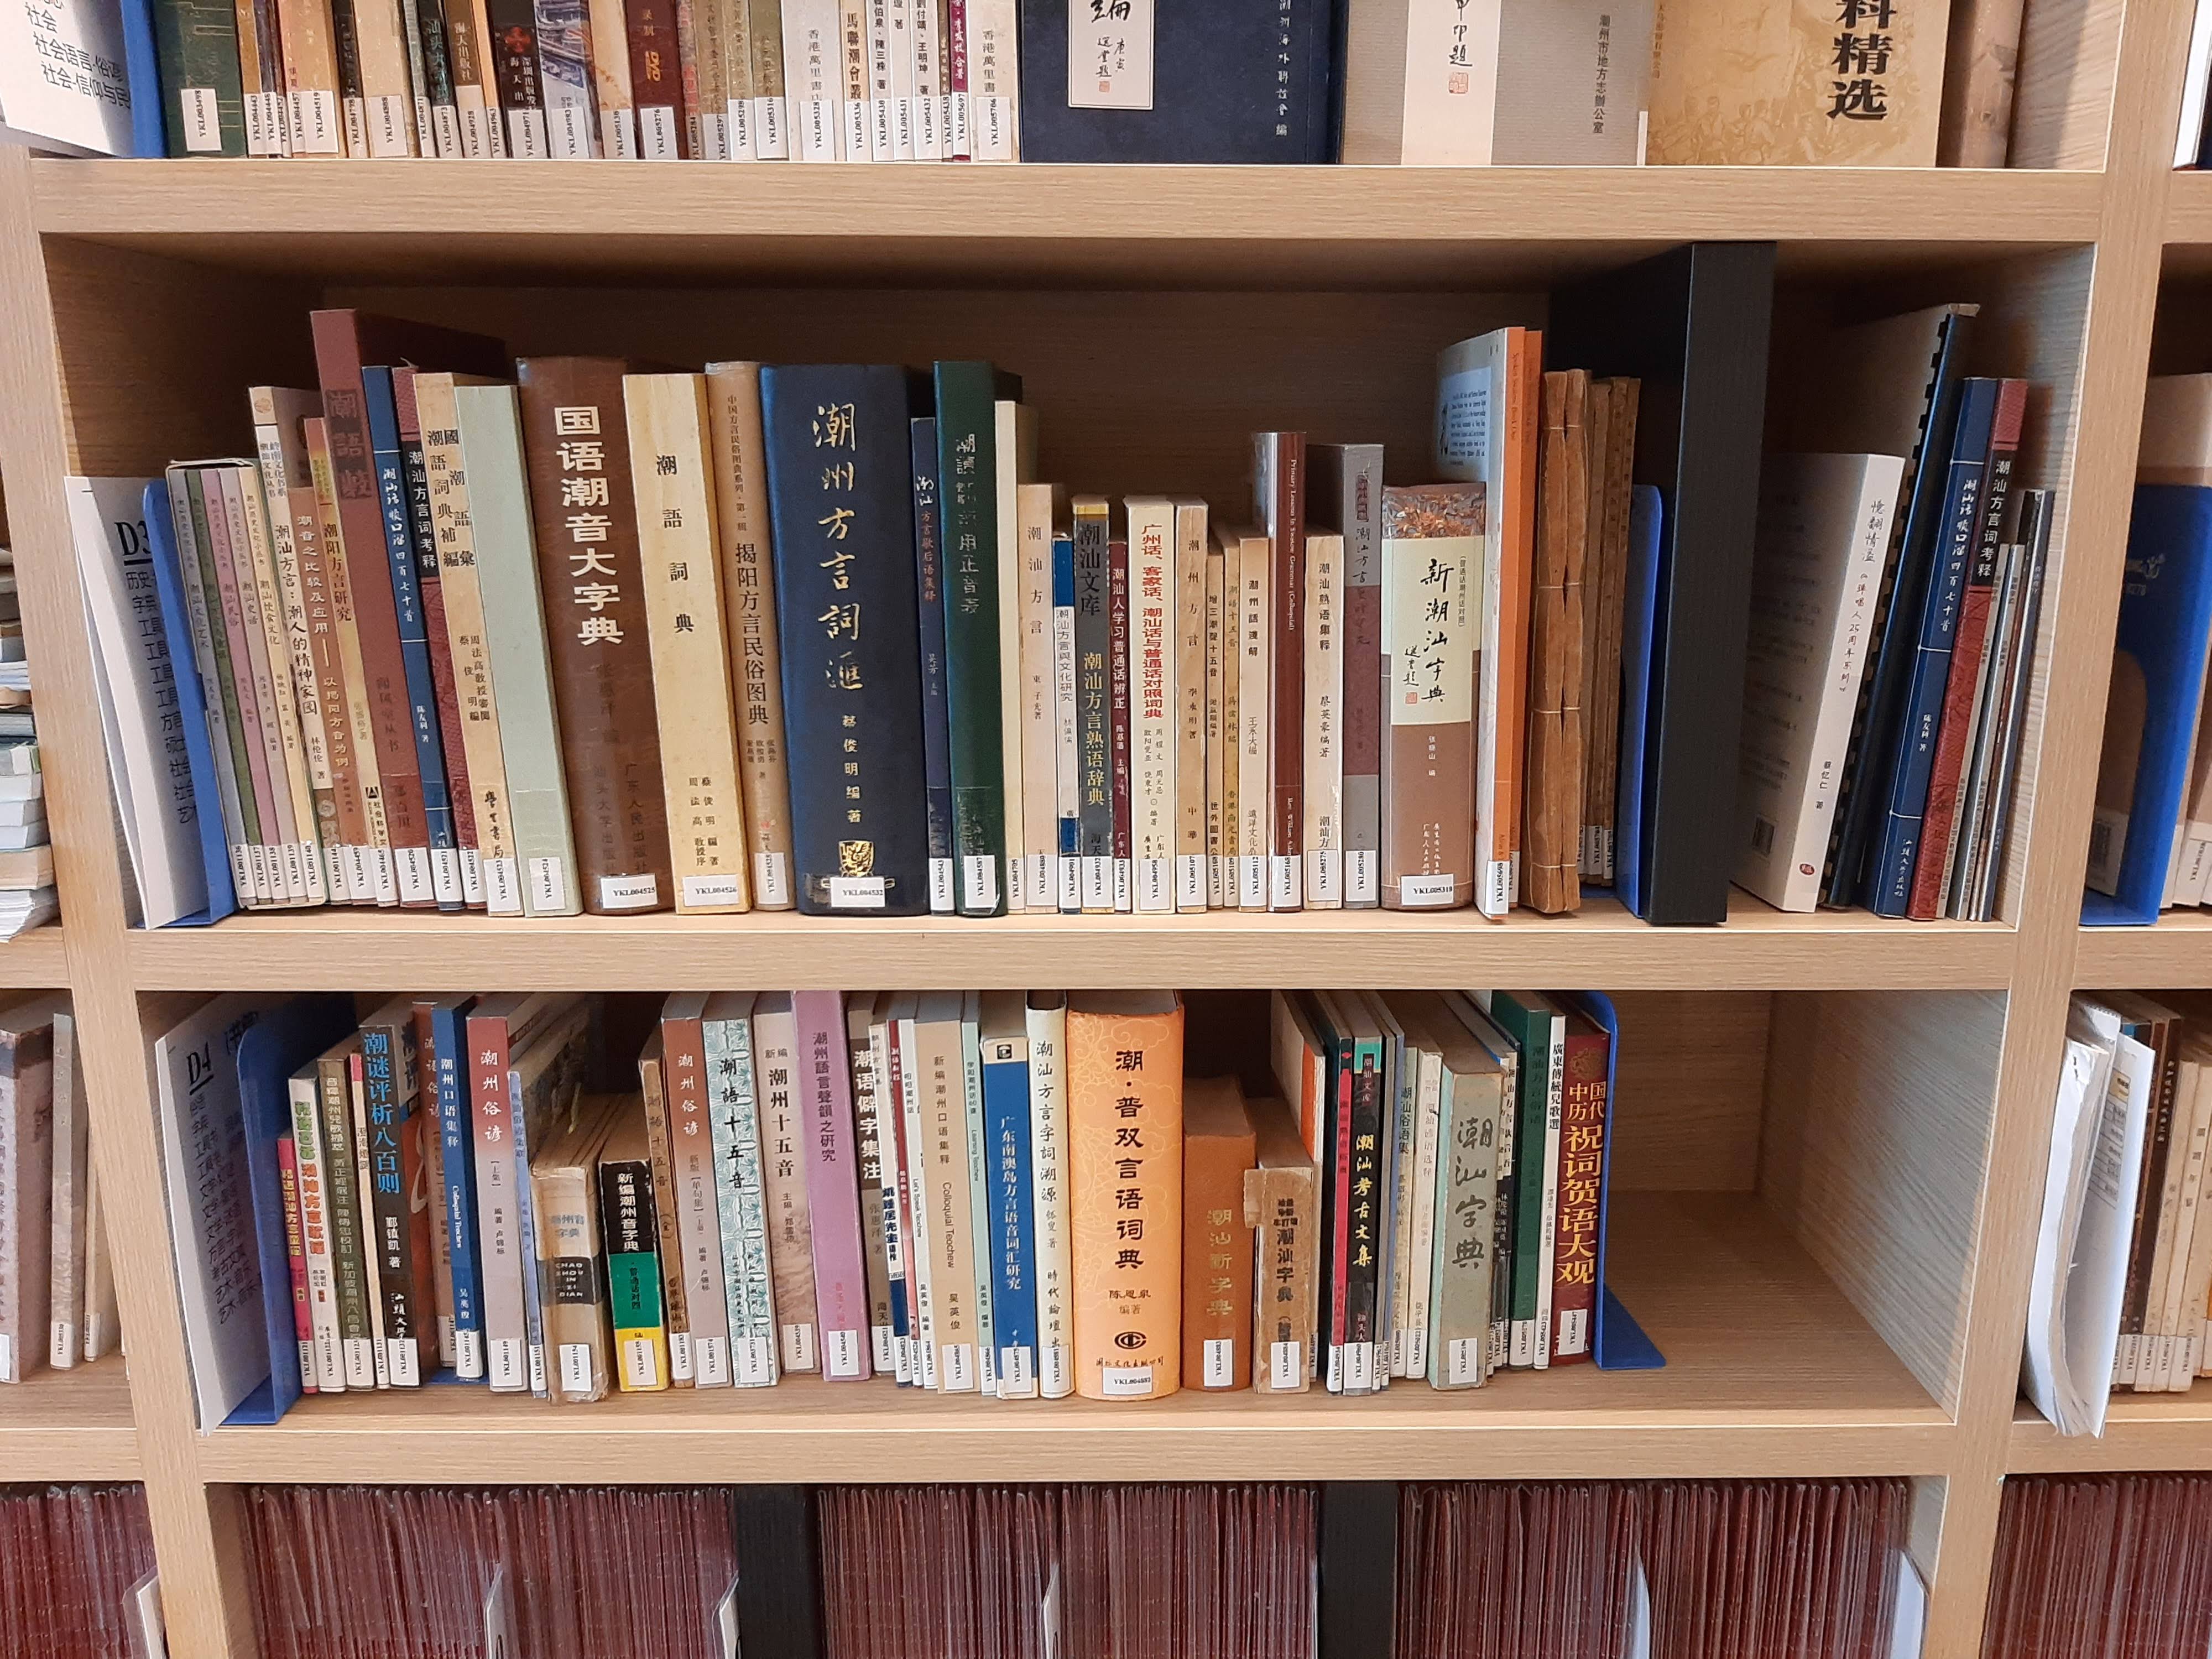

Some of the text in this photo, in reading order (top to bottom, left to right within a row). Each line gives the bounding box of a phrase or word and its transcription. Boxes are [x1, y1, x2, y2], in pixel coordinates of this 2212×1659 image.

[25, 5, 58, 33] 社会
[293, 93, 302, 138] YKL004457
[314, 92, 324, 139] YKL004519
[441, 107, 452, 152] YKL004873
[523, 112, 533, 156] YKL004971
[654, 109, 664, 154] YKL005276
[716, 115, 726, 159] YKL005297
[738, 101, 746, 147] YKL005298
[768, 98, 776, 144] YKL005316
[813, 102, 822, 148] YKL005328
[854, 103, 863, 149] YKL005336
[878, 100, 886, 147] YKL005430
[924, 98, 932, 145] YKL005432
[408, 450, 439, 569] 潮汕方言词考释
[554, 406, 624, 646] 国语潮音大字典
[1977, 460, 2011, 577] 潮汕方言词考释
[323, 523, 352, 622] 潮阳方言研究
[656, 455, 695, 634] 潮語詞典
[1079, 524, 1100, 616] 潮汕文库
[1027, 525, 1043, 634] 潮汕方言
[1187, 539, 1199, 646] 潮州方言
[735, 543, 769, 726] 揭阳方言民俗图典
[1112, 567, 1126, 709] 潮汕人学习普通话辨正
[1141, 524, 1164, 718] 广州话、客家话、潮汕话与普通话对照词典
[1420, 558, 1455, 703] 新潮汕字典
[1083, 653, 1105, 806] 潮汕方言熟语辞典
[236, 846, 247, 886] YKL001136
[254, 847, 265, 886] YKL001137
[269, 847, 281, 887] YKL001138
[288, 844, 299, 884] YKL001139
[306, 846, 316, 885] YKL001140
[332, 849, 342, 888] YKL001144
[409, 849, 419, 889] YKL004520
[441, 851, 451, 890] YKL004521
[467, 851, 478, 891] YKL004522
[497, 860, 507, 900] YKL004523
[542, 859, 552, 899] YKL004524
[613, 887, 655, 896] YKL004525
[363, 1032, 400, 1194] 潮谜评析八百则
[479, 1051, 503, 1142] 潮州俗谚
[678, 1053, 698, 1137] 潮州俗谚
[720, 1058, 744, 1188] 潮語十五音
[768, 1068, 795, 1177] 潮州十五音
[854, 1050, 881, 1179] 潮语僻字集注
[1114, 1050, 1144, 1269] 潮·普双言语词典
[617, 1172, 640, 1253] 新编潮州音字典
[942, 1182, 955, 1269] Colloquial Teochew
[1001, 1115, 1021, 1290] 广东南澳岛方言语音词汇研究
[1352, 1134, 1375, 1268] 潮汕考古文集
[1452, 1116, 1494, 1271] 潮汕字典
[1556, 1123, 1603, 1286] 祝词贺语大观
[1119, 1303, 1141, 1315] 编著
